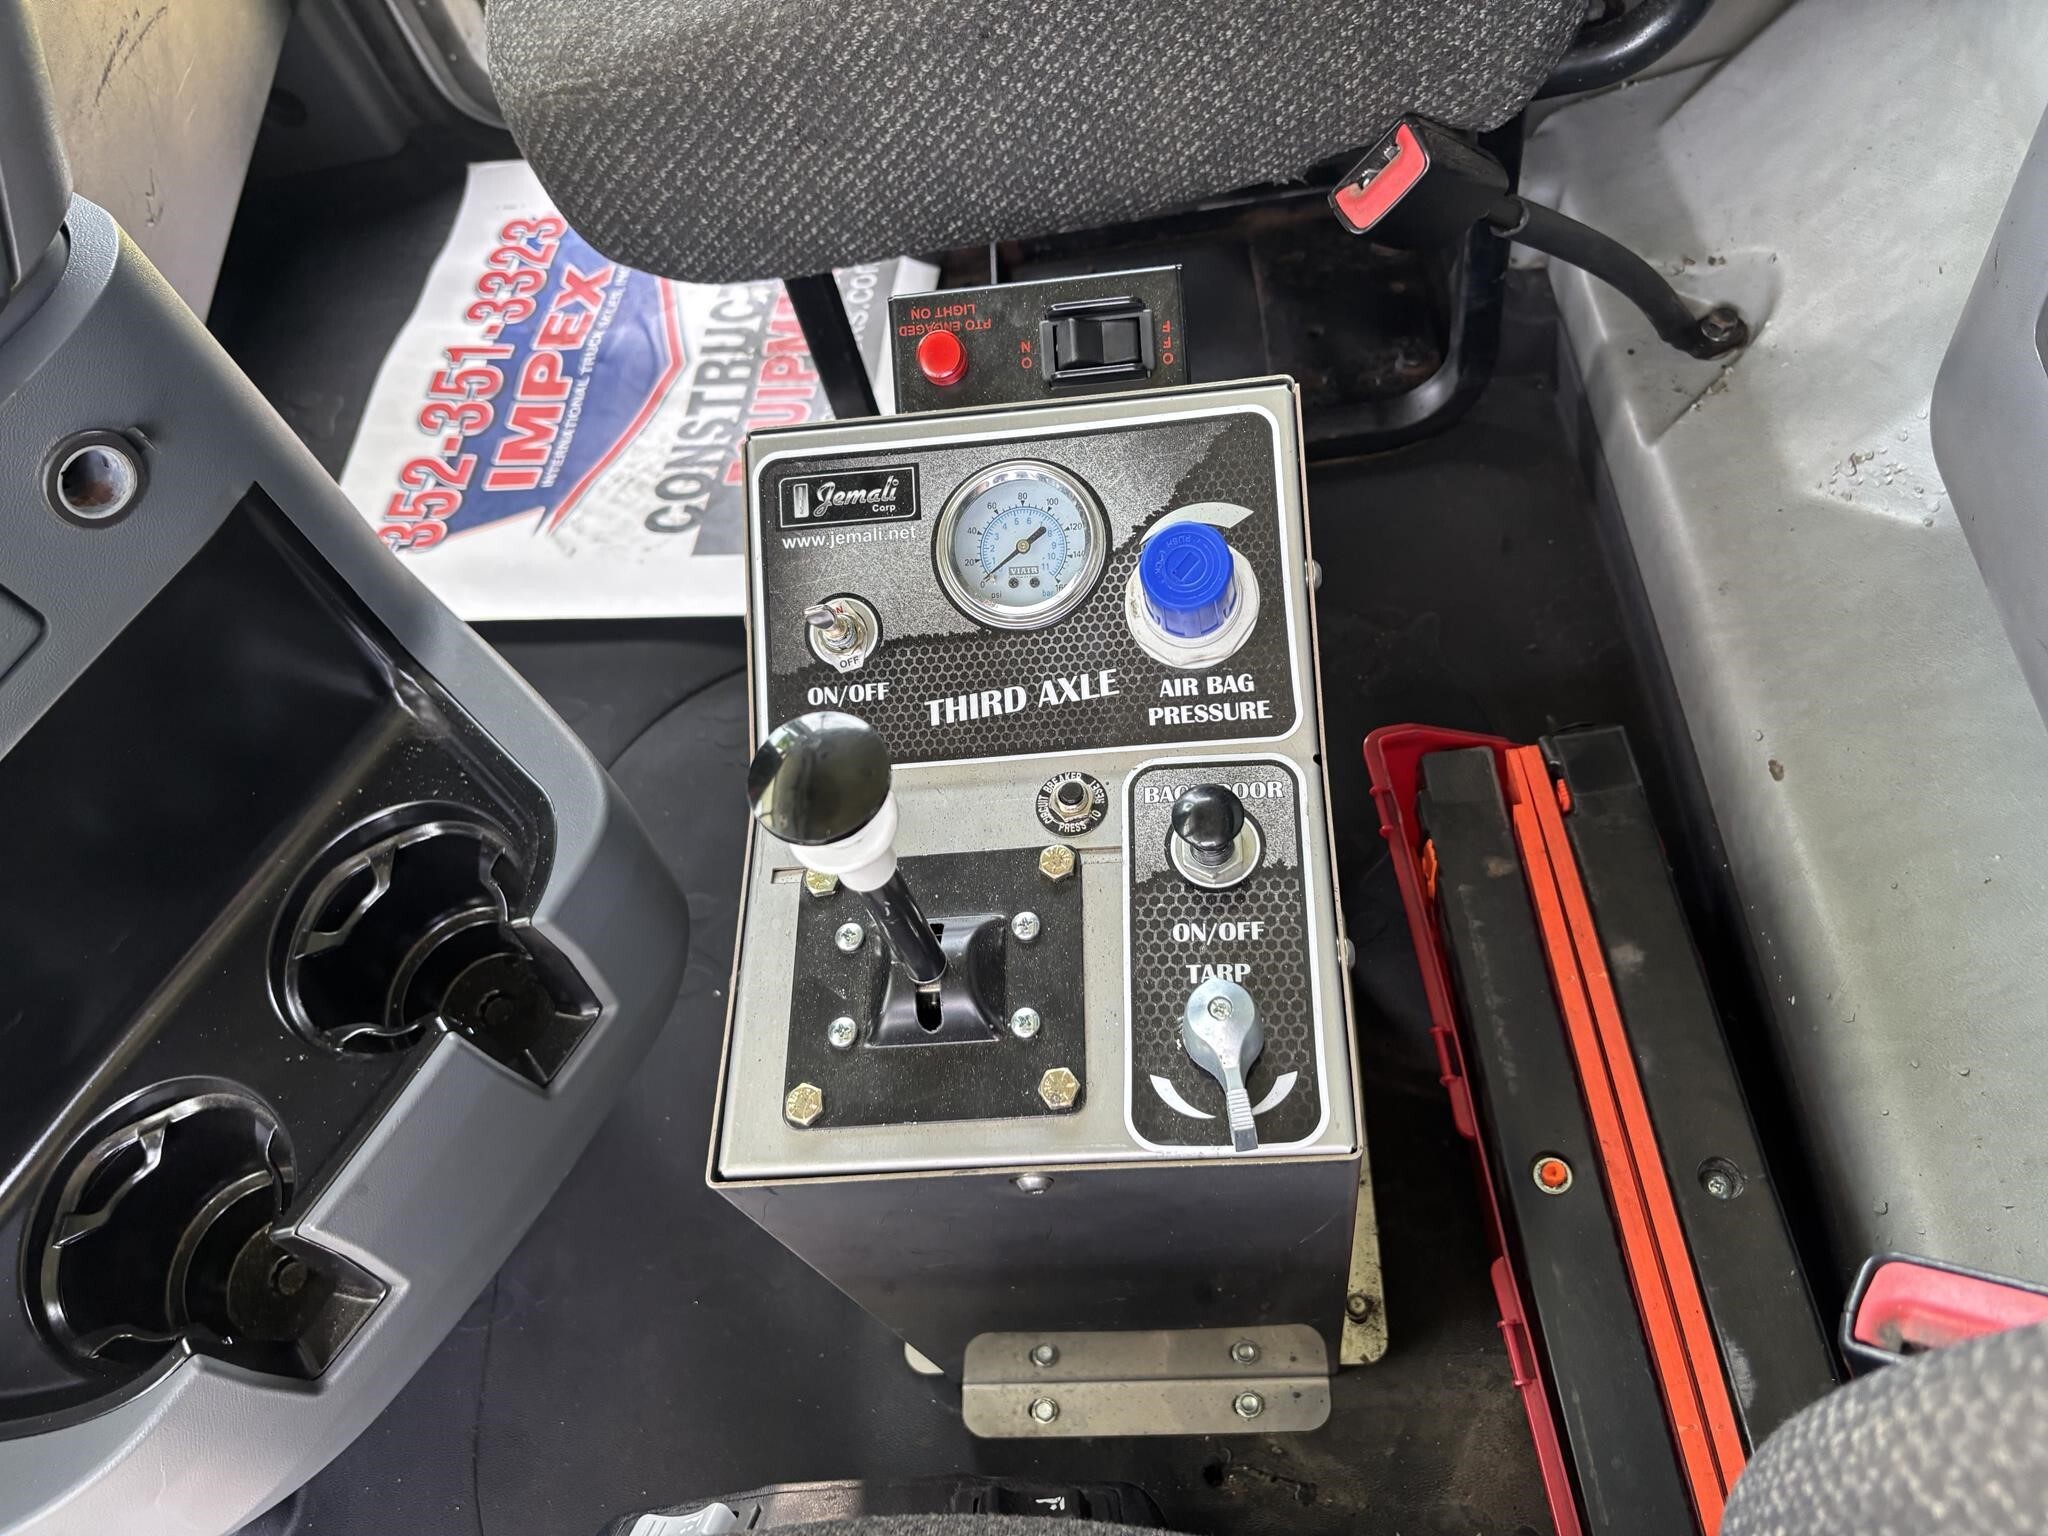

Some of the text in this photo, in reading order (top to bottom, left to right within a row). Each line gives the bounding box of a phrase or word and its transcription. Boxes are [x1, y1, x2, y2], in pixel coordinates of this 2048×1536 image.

[911, 303, 976, 320] LIGHT ON
[899, 318, 992, 336] PTO ENGAGED
[1162, 320, 1174, 365] OFF
[1020, 341, 1032, 369] ON
[376, 215, 568, 551] 352-351-3323
[482, 263, 616, 491] IMPEX
[541, 376, 590, 488] INTERNATIONAL
[578, 330, 605, 376] TRUCK
[644, 284, 771, 534] CONSTRUC
[813, 475, 900, 517] Jemali
[987, 502, 997, 510] 60
[1017, 492, 1028, 500] 80
[1046, 498, 1059, 506] 100
[872, 504, 896, 513] Corp
[782, 526, 917, 549] www.jemali.net
[967, 527, 977, 535] 40
[1070, 523, 1083, 531] 120
[1009, 567, 1039, 575] VIAIR
[991, 591, 1002, 599] psi
[839, 656, 860, 669] OFF
[807, 682, 890, 707] ON/OFF
[924, 668, 1120, 726] THIRD AXLE
[1159, 673, 1255, 698] AIR BAG
[1149, 700, 1273, 726] PRESSURE
[1038, 772, 1082, 824] CIRCUIT BREAKER
[1144, 781, 1284, 804] BAC OOR
[1058, 822, 1087, 833] PRESS
[1088, 780, 1105, 804] RESET
[1172, 921, 1265, 946] ON/OFF
[1185, 964, 1251, 984] TARP
